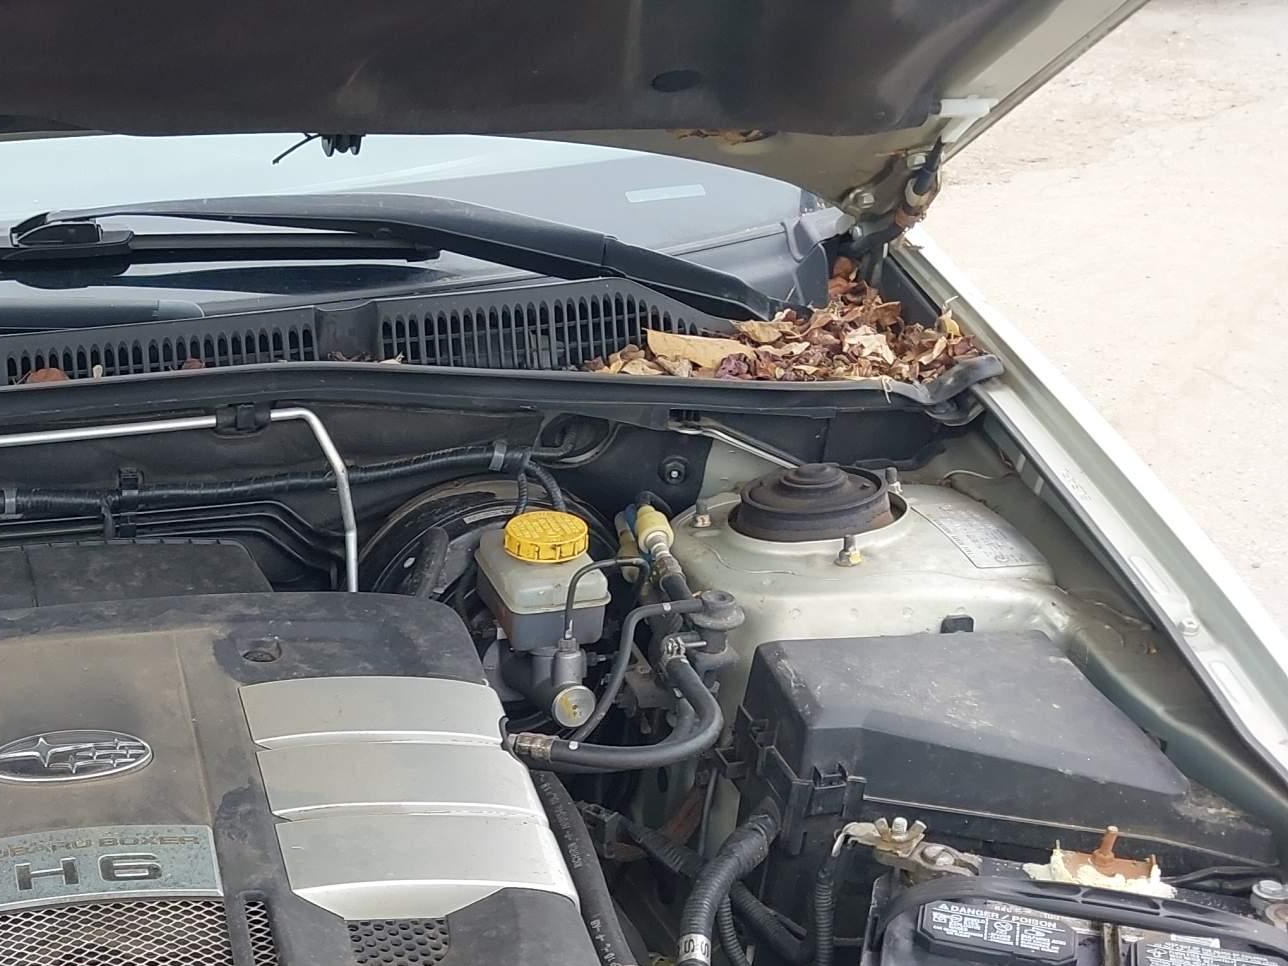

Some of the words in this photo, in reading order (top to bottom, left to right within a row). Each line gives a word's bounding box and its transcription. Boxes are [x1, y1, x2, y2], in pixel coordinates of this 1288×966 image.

[98, 835, 201, 849] BOXER
[950, 905, 1000, 920] DANGER
[1011, 915, 1057, 929] POISON
